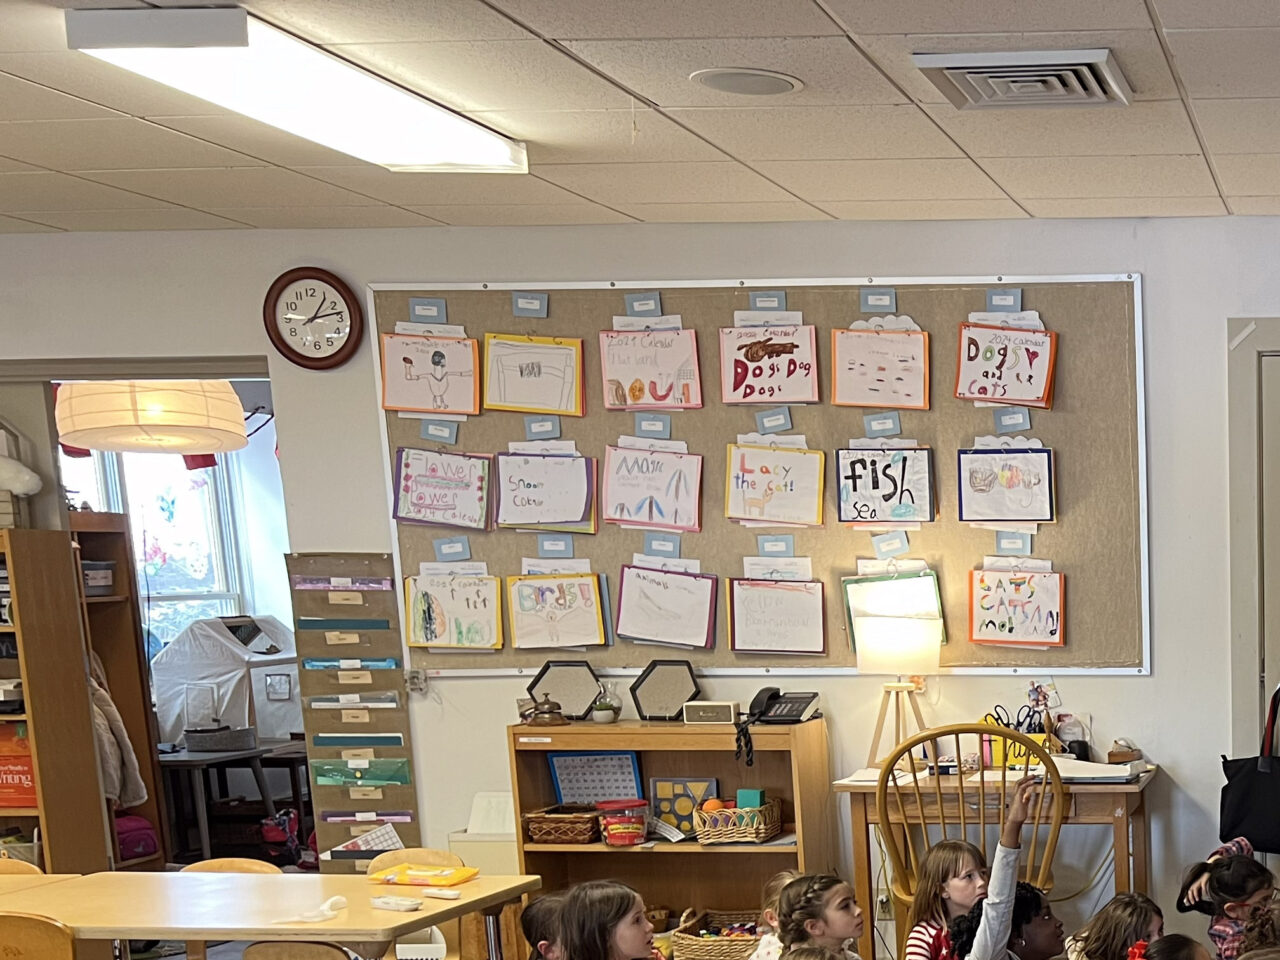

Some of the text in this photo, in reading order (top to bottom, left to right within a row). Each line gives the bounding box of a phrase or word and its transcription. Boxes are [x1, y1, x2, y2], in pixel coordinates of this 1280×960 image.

[296, 291, 302, 301] 11
[305, 288, 316, 297] 12
[286, 302, 297, 311] 10
[330, 301, 337, 310] 2
[337, 314, 343, 323] 3
[290, 328, 297, 337] 8
[326, 337, 333, 346] 5
[989, 333, 1011, 345] 2024
[314, 341, 321, 350] 6
[967, 337, 1021, 371] Dogs
[982, 370, 1003, 381] and
[740, 453, 791, 480] Lacy
[734, 473, 794, 492] the cat!
[844, 456, 915, 504] fish
[853, 502, 878, 519] sea
